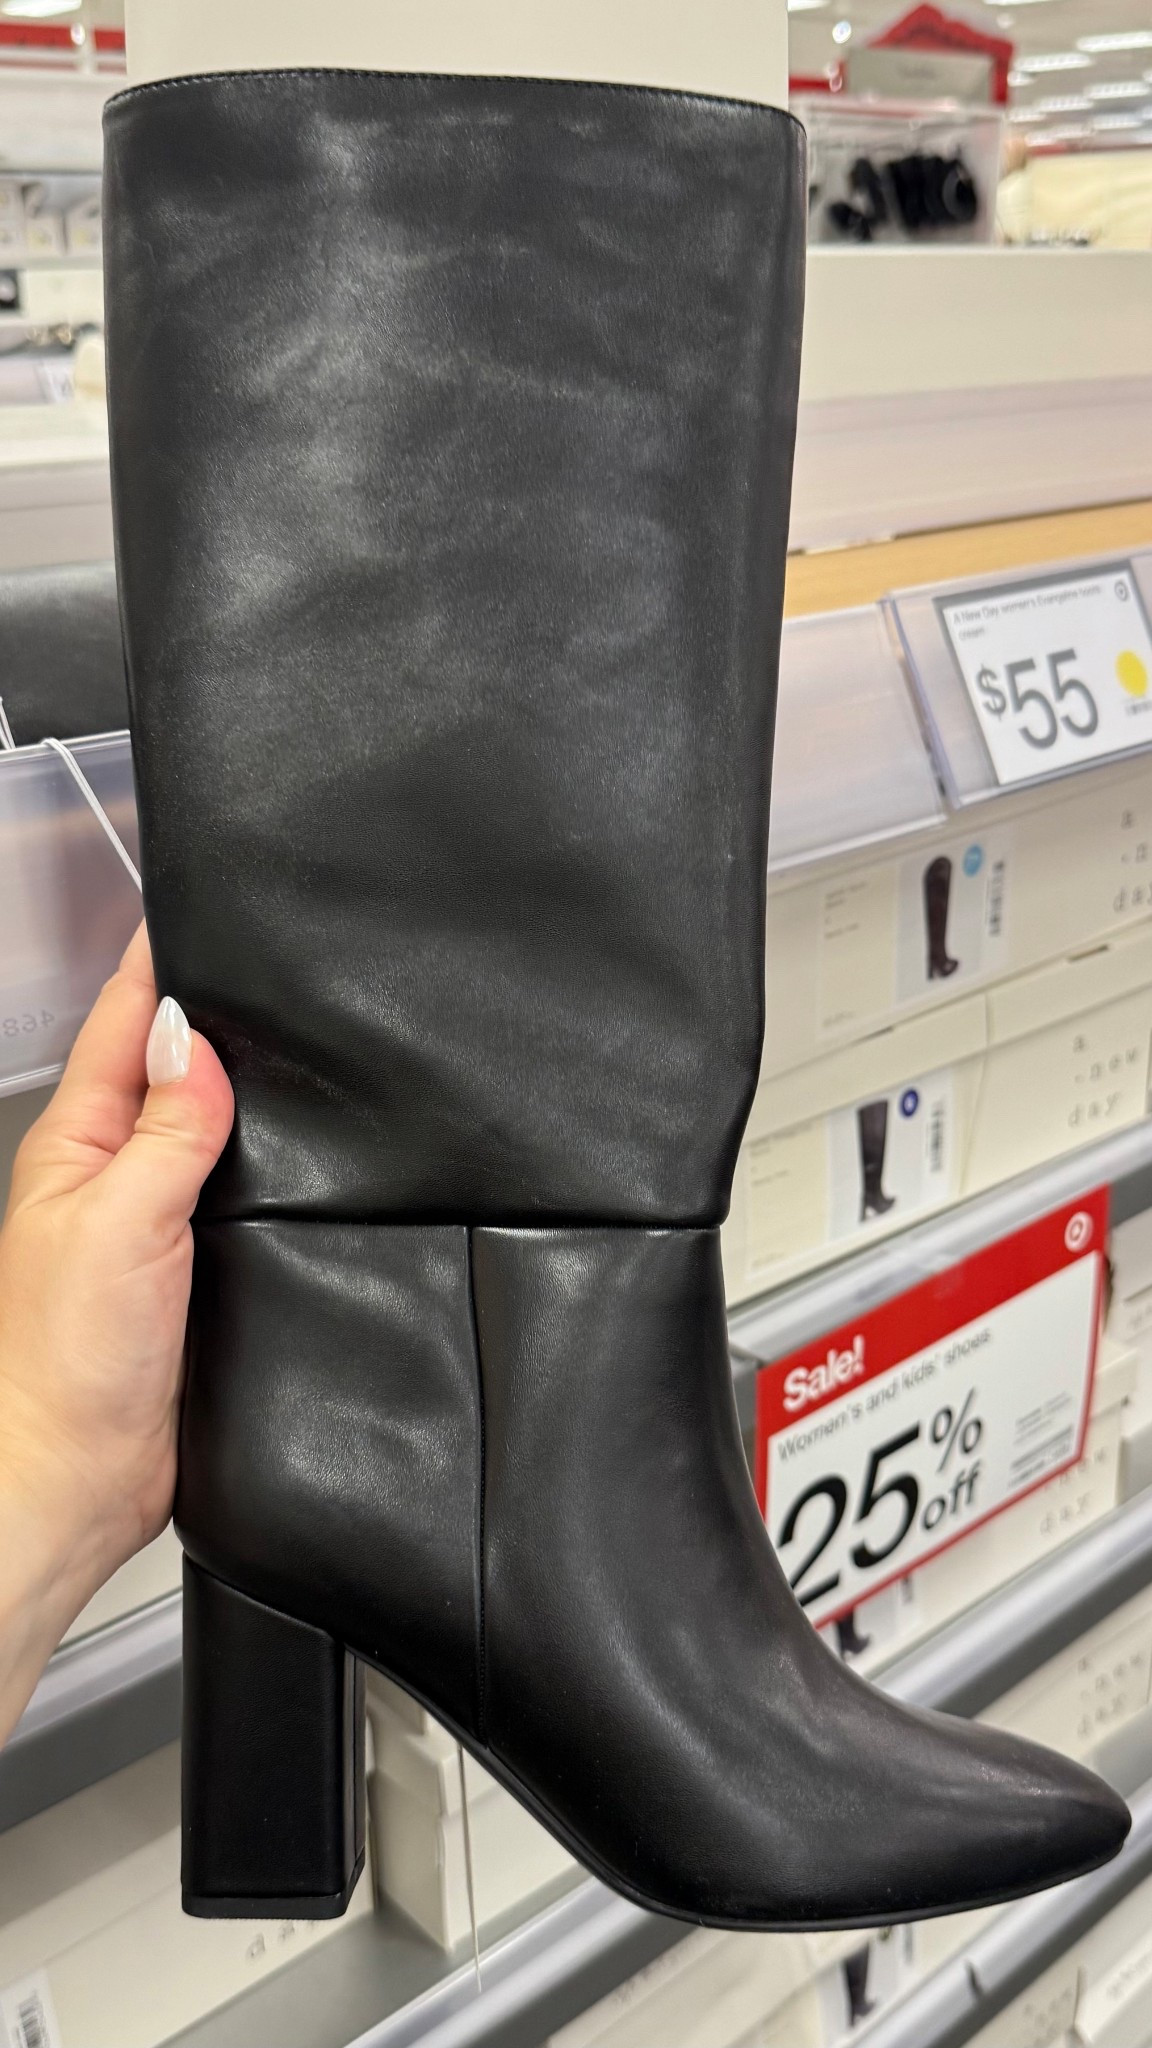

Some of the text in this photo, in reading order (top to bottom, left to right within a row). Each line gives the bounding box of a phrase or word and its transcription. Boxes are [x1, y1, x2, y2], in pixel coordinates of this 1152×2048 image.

[962, 608, 982, 623] New
[975, 648, 1099, 750] $55
[778, 1403, 864, 1461] Women's
[866, 1380, 900, 1411] and
[944, 1329, 991, 1365] shoes
[783, 1334, 865, 1411] Sale!
[921, 1459, 980, 1532] off
